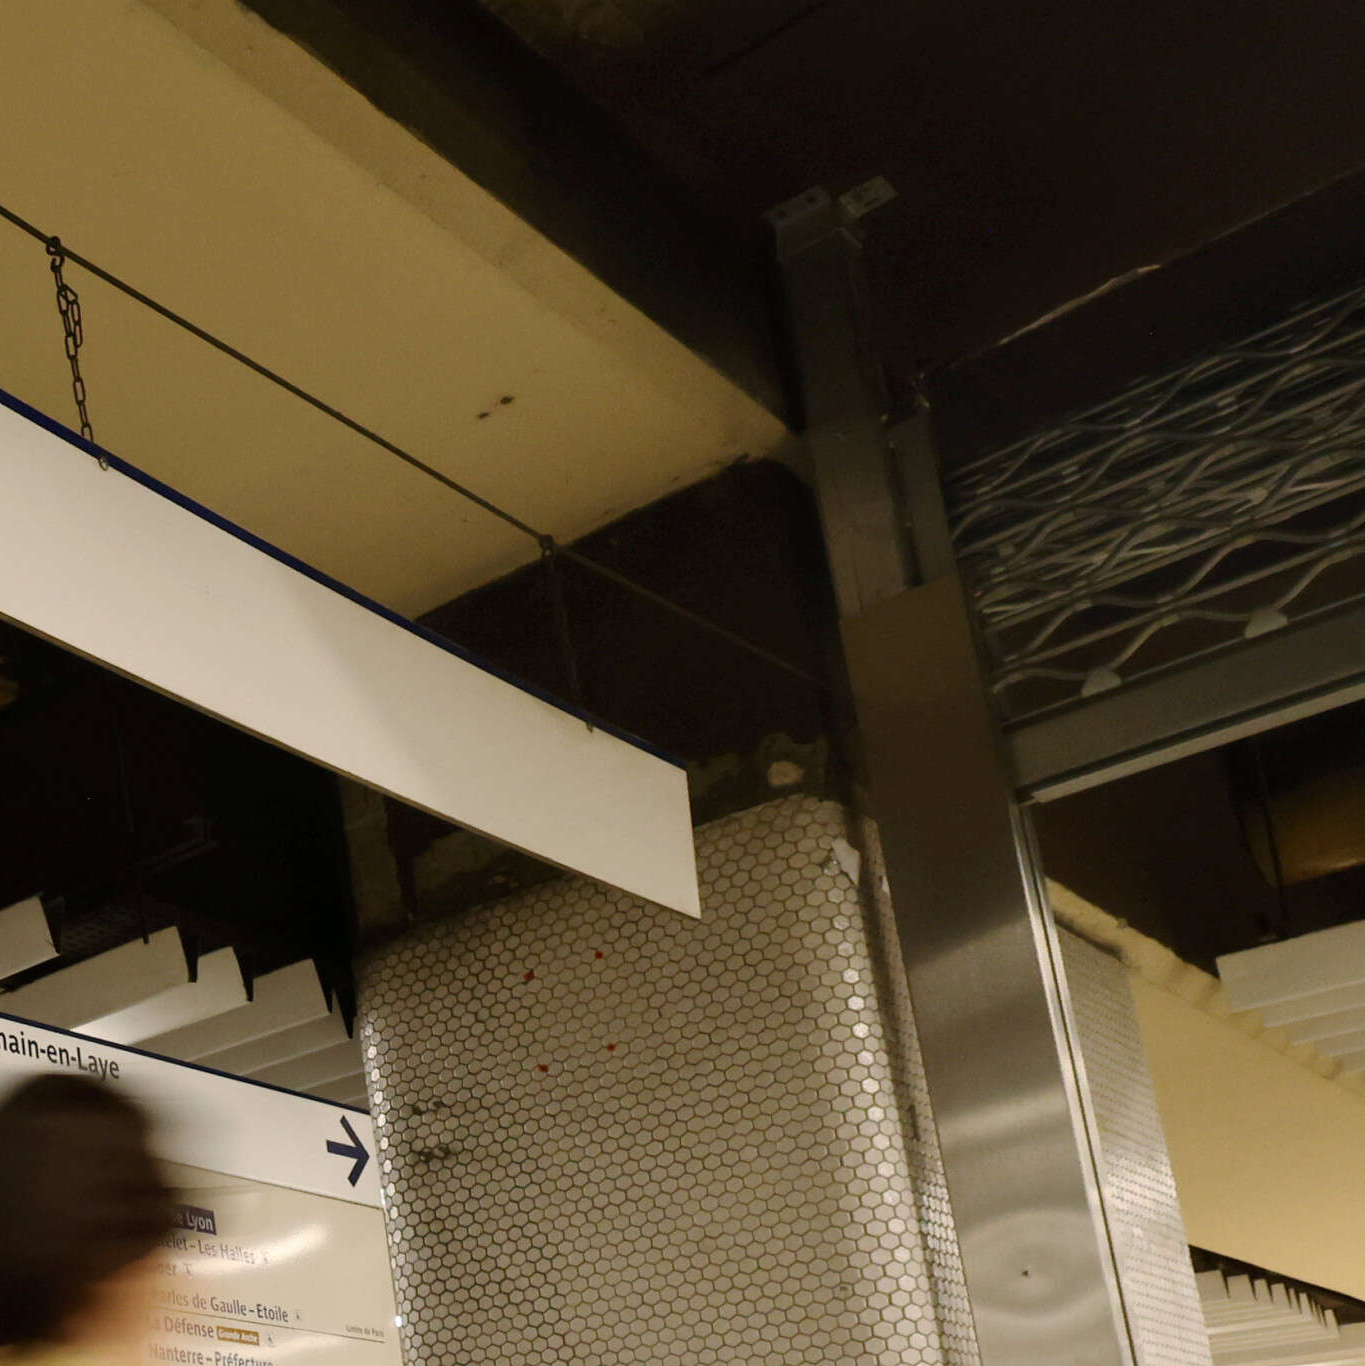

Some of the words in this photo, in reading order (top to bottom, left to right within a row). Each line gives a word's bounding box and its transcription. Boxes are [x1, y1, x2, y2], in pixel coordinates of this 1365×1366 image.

[186, 1212, 213, 1232] Lyon
[198, 1239, 216, 1257] Les
[193, 1294, 207, 1309] de
[210, 1297, 247, 1316] Gaulle
[256, 1304, 289, 1323] Etoile
[164, 1316, 214, 1338] Défense
[148, 1343, 204, 1366] Nanterre
